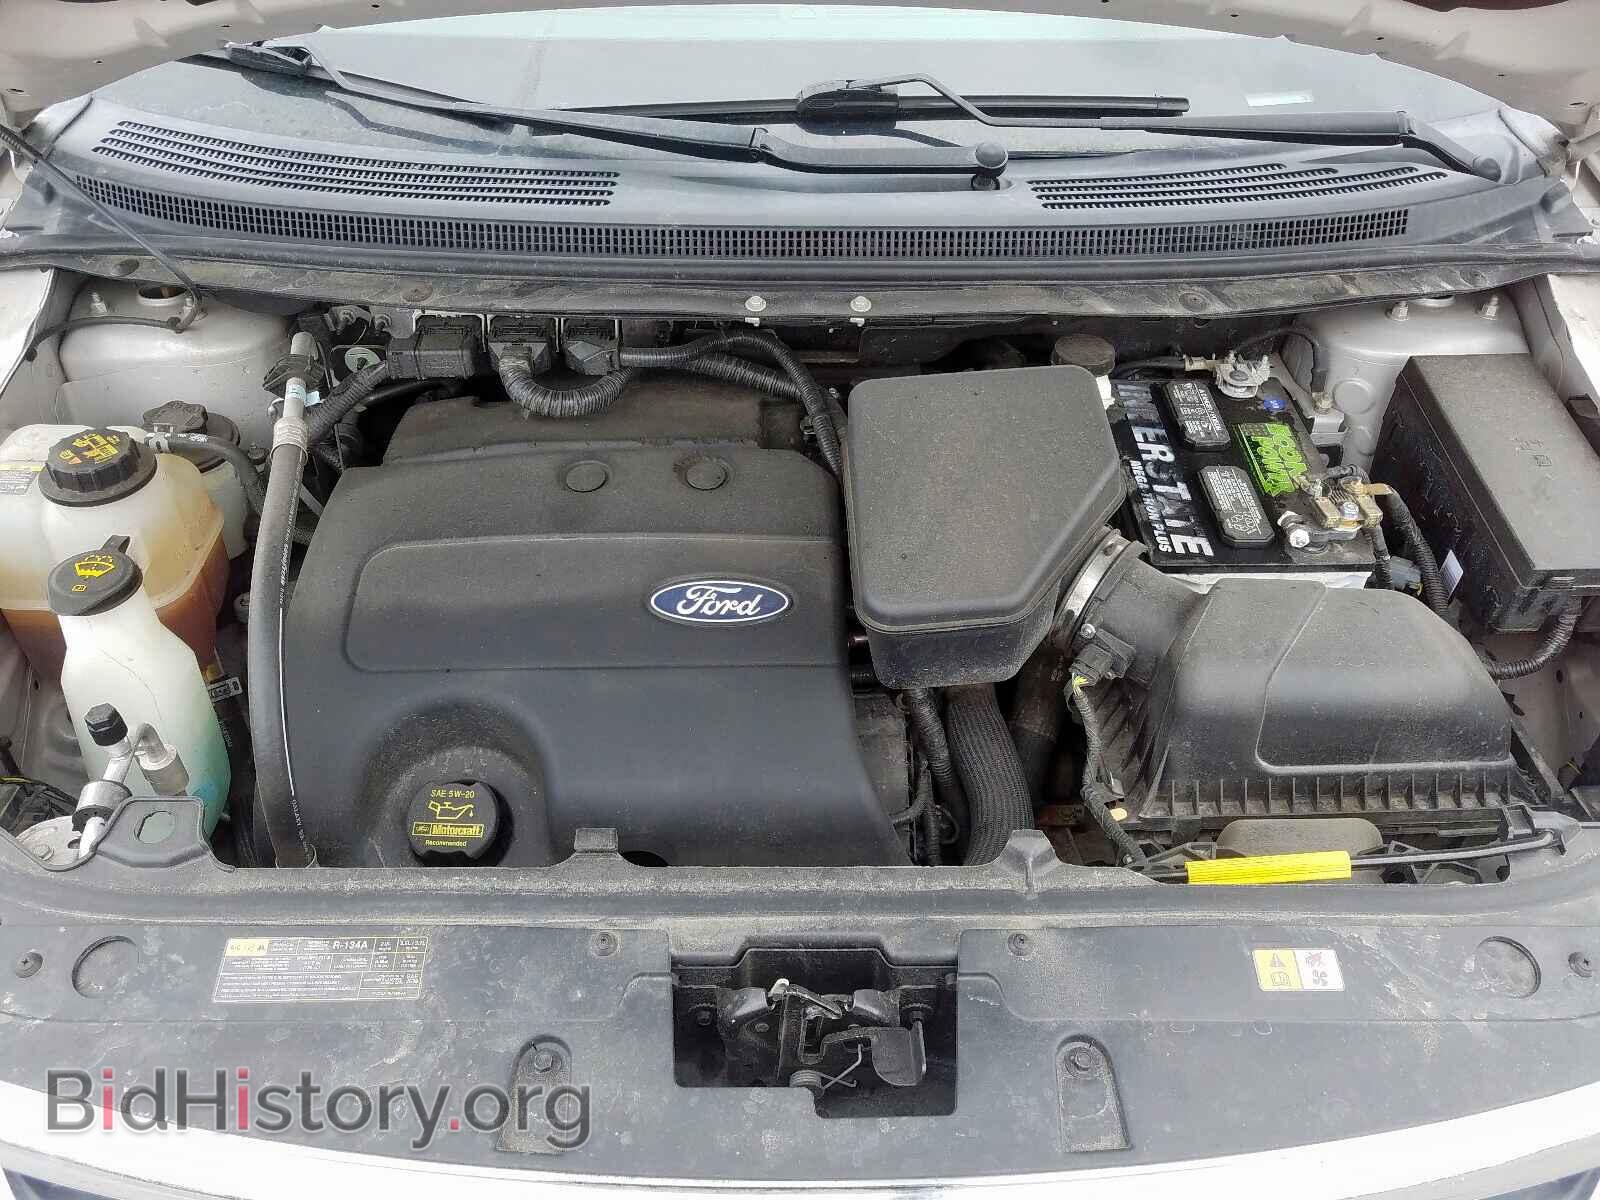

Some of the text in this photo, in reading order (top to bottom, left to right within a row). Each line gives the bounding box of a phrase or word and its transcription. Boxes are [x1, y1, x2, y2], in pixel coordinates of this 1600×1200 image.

[1151, 520, 1173, 553] PLUS
[676, 585, 762, 616] Ford
[430, 789, 475, 799] SAE 5W-20
[431, 824, 482, 836] Motorcraft
[424, 839, 467, 848] Recommended
[332, 940, 368, 951] R-134A
